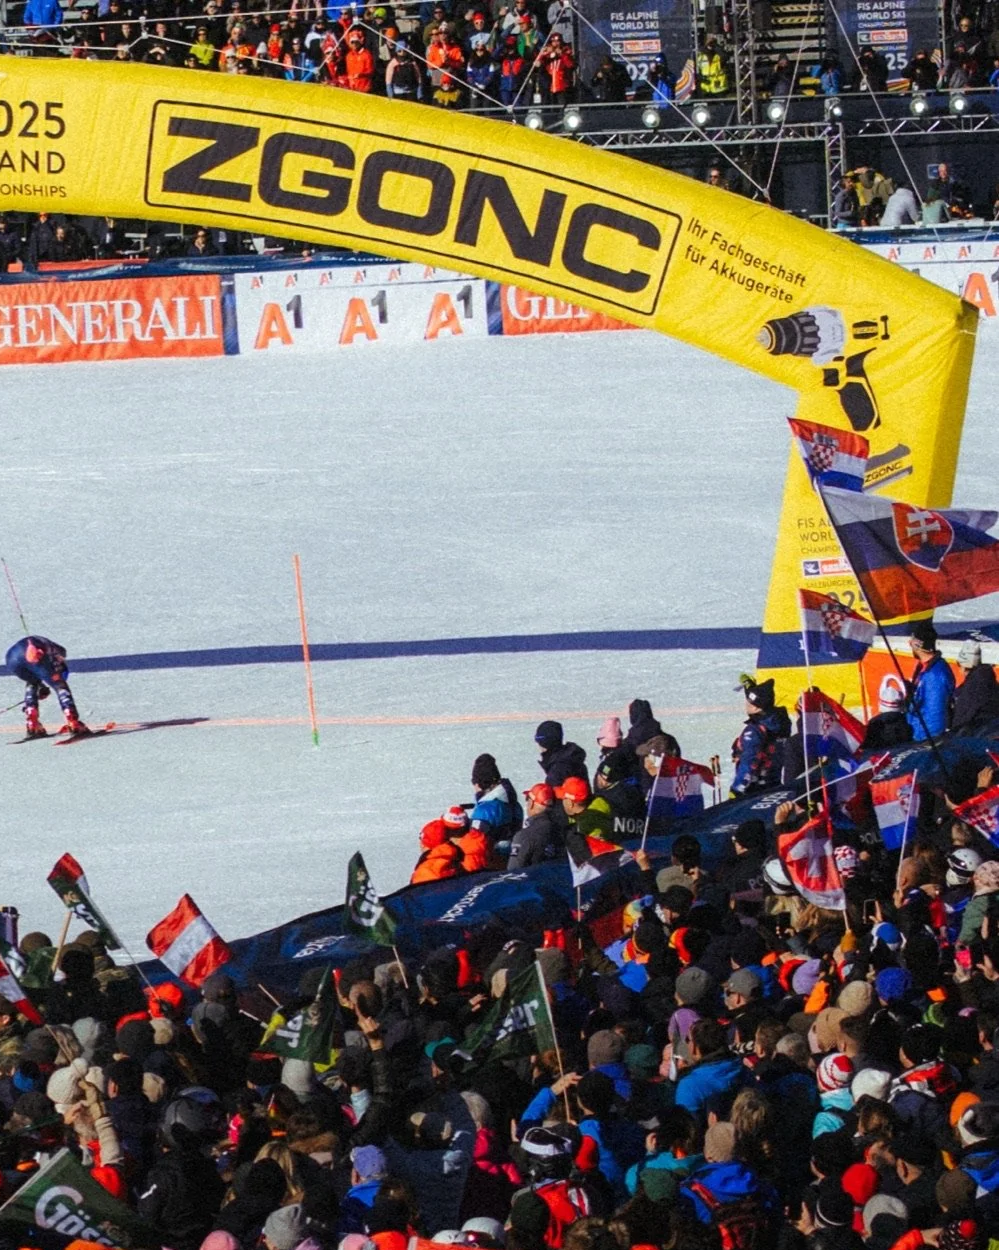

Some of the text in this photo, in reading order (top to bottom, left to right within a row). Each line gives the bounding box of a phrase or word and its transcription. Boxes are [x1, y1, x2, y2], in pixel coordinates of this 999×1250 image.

[857, 1, 906, 11] FIS ALPINE
[610, 10, 659, 21] FIS ALPINE
[857, 11, 907, 21] WORLD SKI
[611, 21, 659, 31] WORLD SKI
[162, 116, 662, 293] ZGONC
[687, 217, 806, 288] Ihr Fachgeschäft
[684, 245, 793, 303] für Akkugeräte
[254, 285, 473, 350] A1 A1 A1
[864, 461, 902, 483] ZGONC
[797, 518, 817, 529] FIS
[800, 531, 834, 542] WORL
